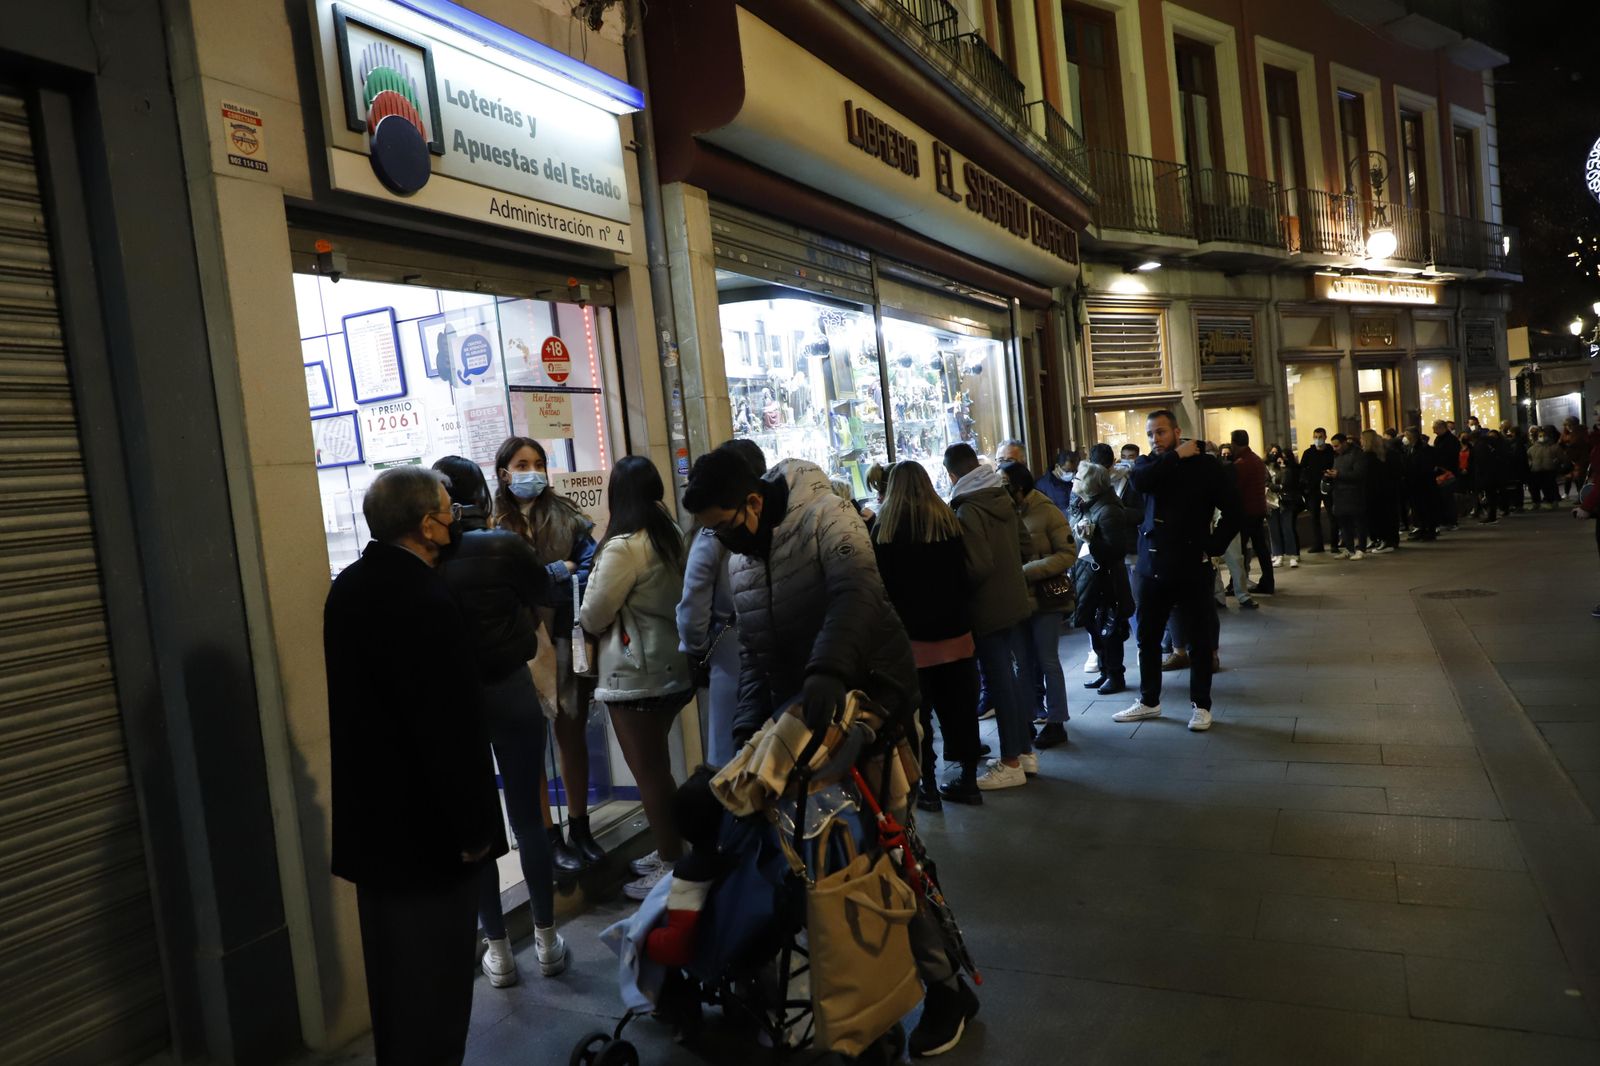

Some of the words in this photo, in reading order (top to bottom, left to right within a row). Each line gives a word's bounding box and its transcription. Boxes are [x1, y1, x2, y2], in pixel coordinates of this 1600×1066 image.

[445, 79, 523, 128] Loterías
[527, 114, 537, 138] y
[844, 99, 921, 179] LIBRERIA
[932, 141, 963, 203] EL
[453, 129, 539, 176] Apuestas
[543, 157, 567, 184] del
[571, 166, 621, 200] Estado
[489, 197, 594, 239] Administración
[617, 229, 625, 245] 4
[545, 341, 563, 356] +18
[378, 402, 412, 415] PREMIO
[470, 408, 498, 418] BOTES
[367, 412, 419, 432] 12061
[571, 475, 603, 488] PREMIO
